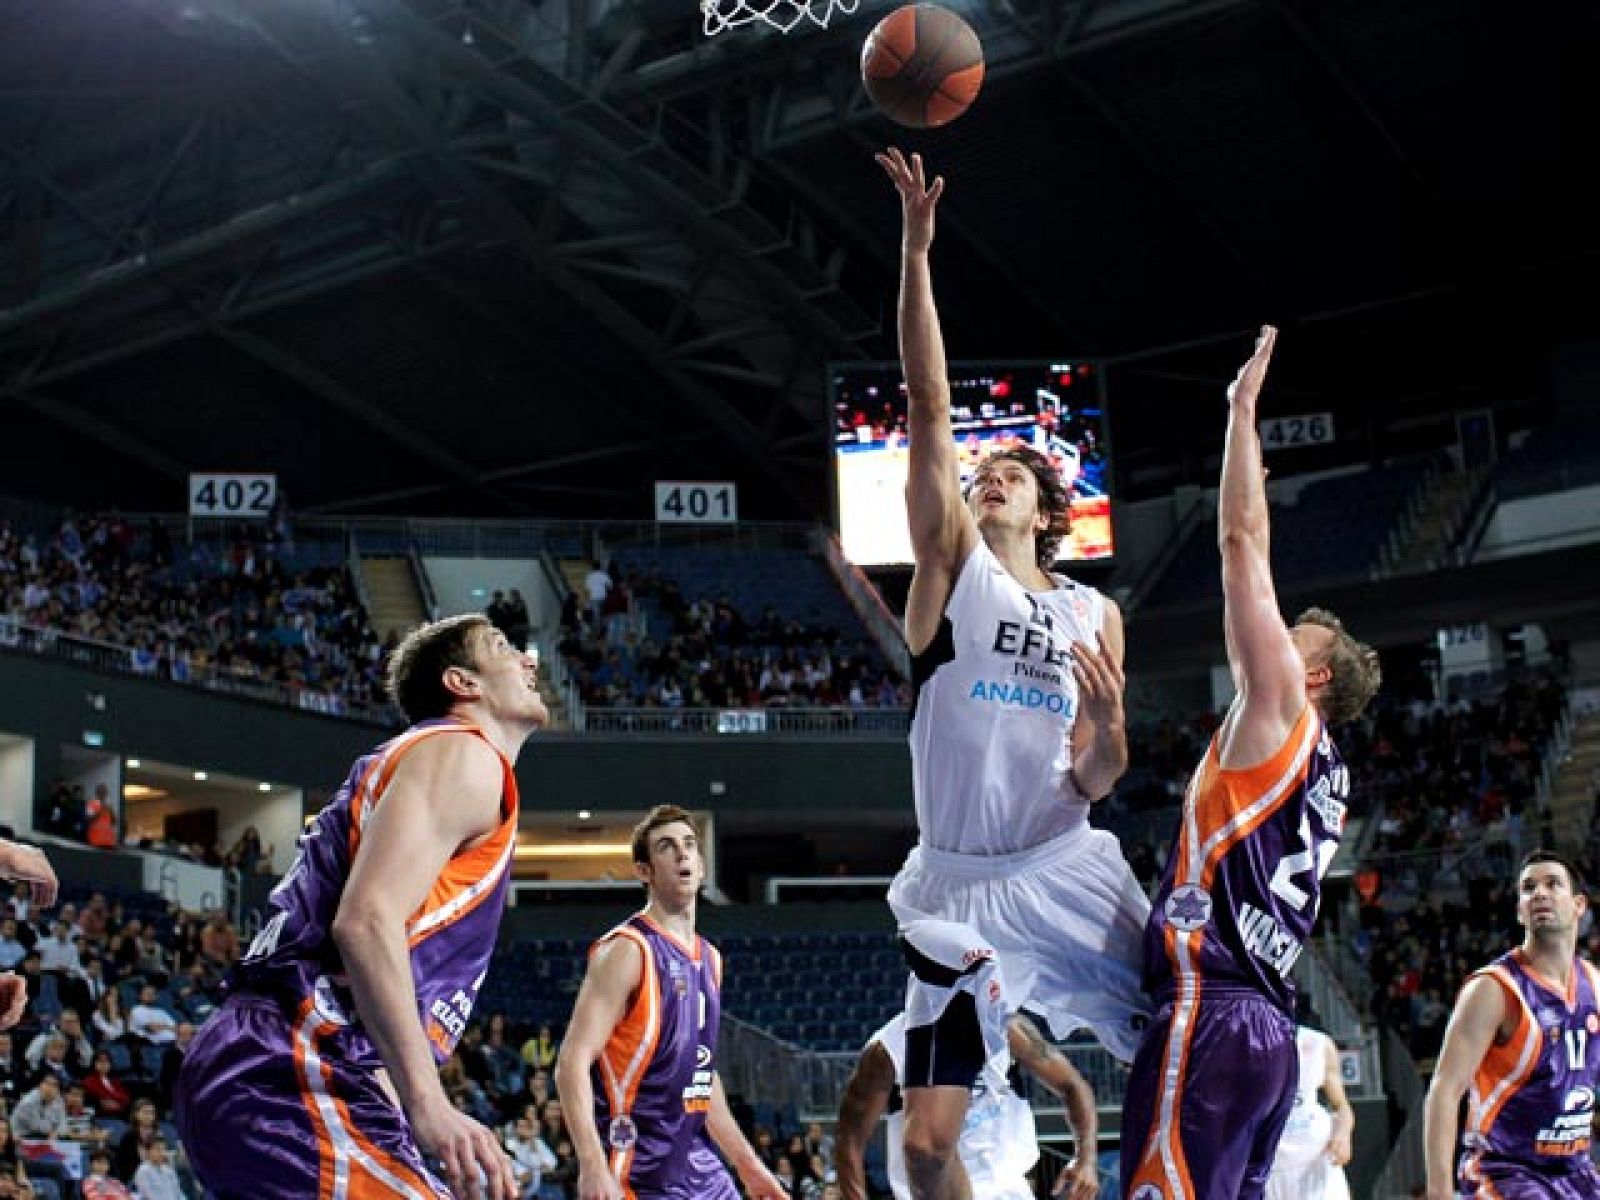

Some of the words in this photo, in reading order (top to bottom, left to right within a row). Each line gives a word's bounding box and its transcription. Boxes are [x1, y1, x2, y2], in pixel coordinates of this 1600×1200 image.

[1267, 416, 1328, 443] 426
[195, 479, 272, 511] 402
[662, 487, 730, 518] 401
